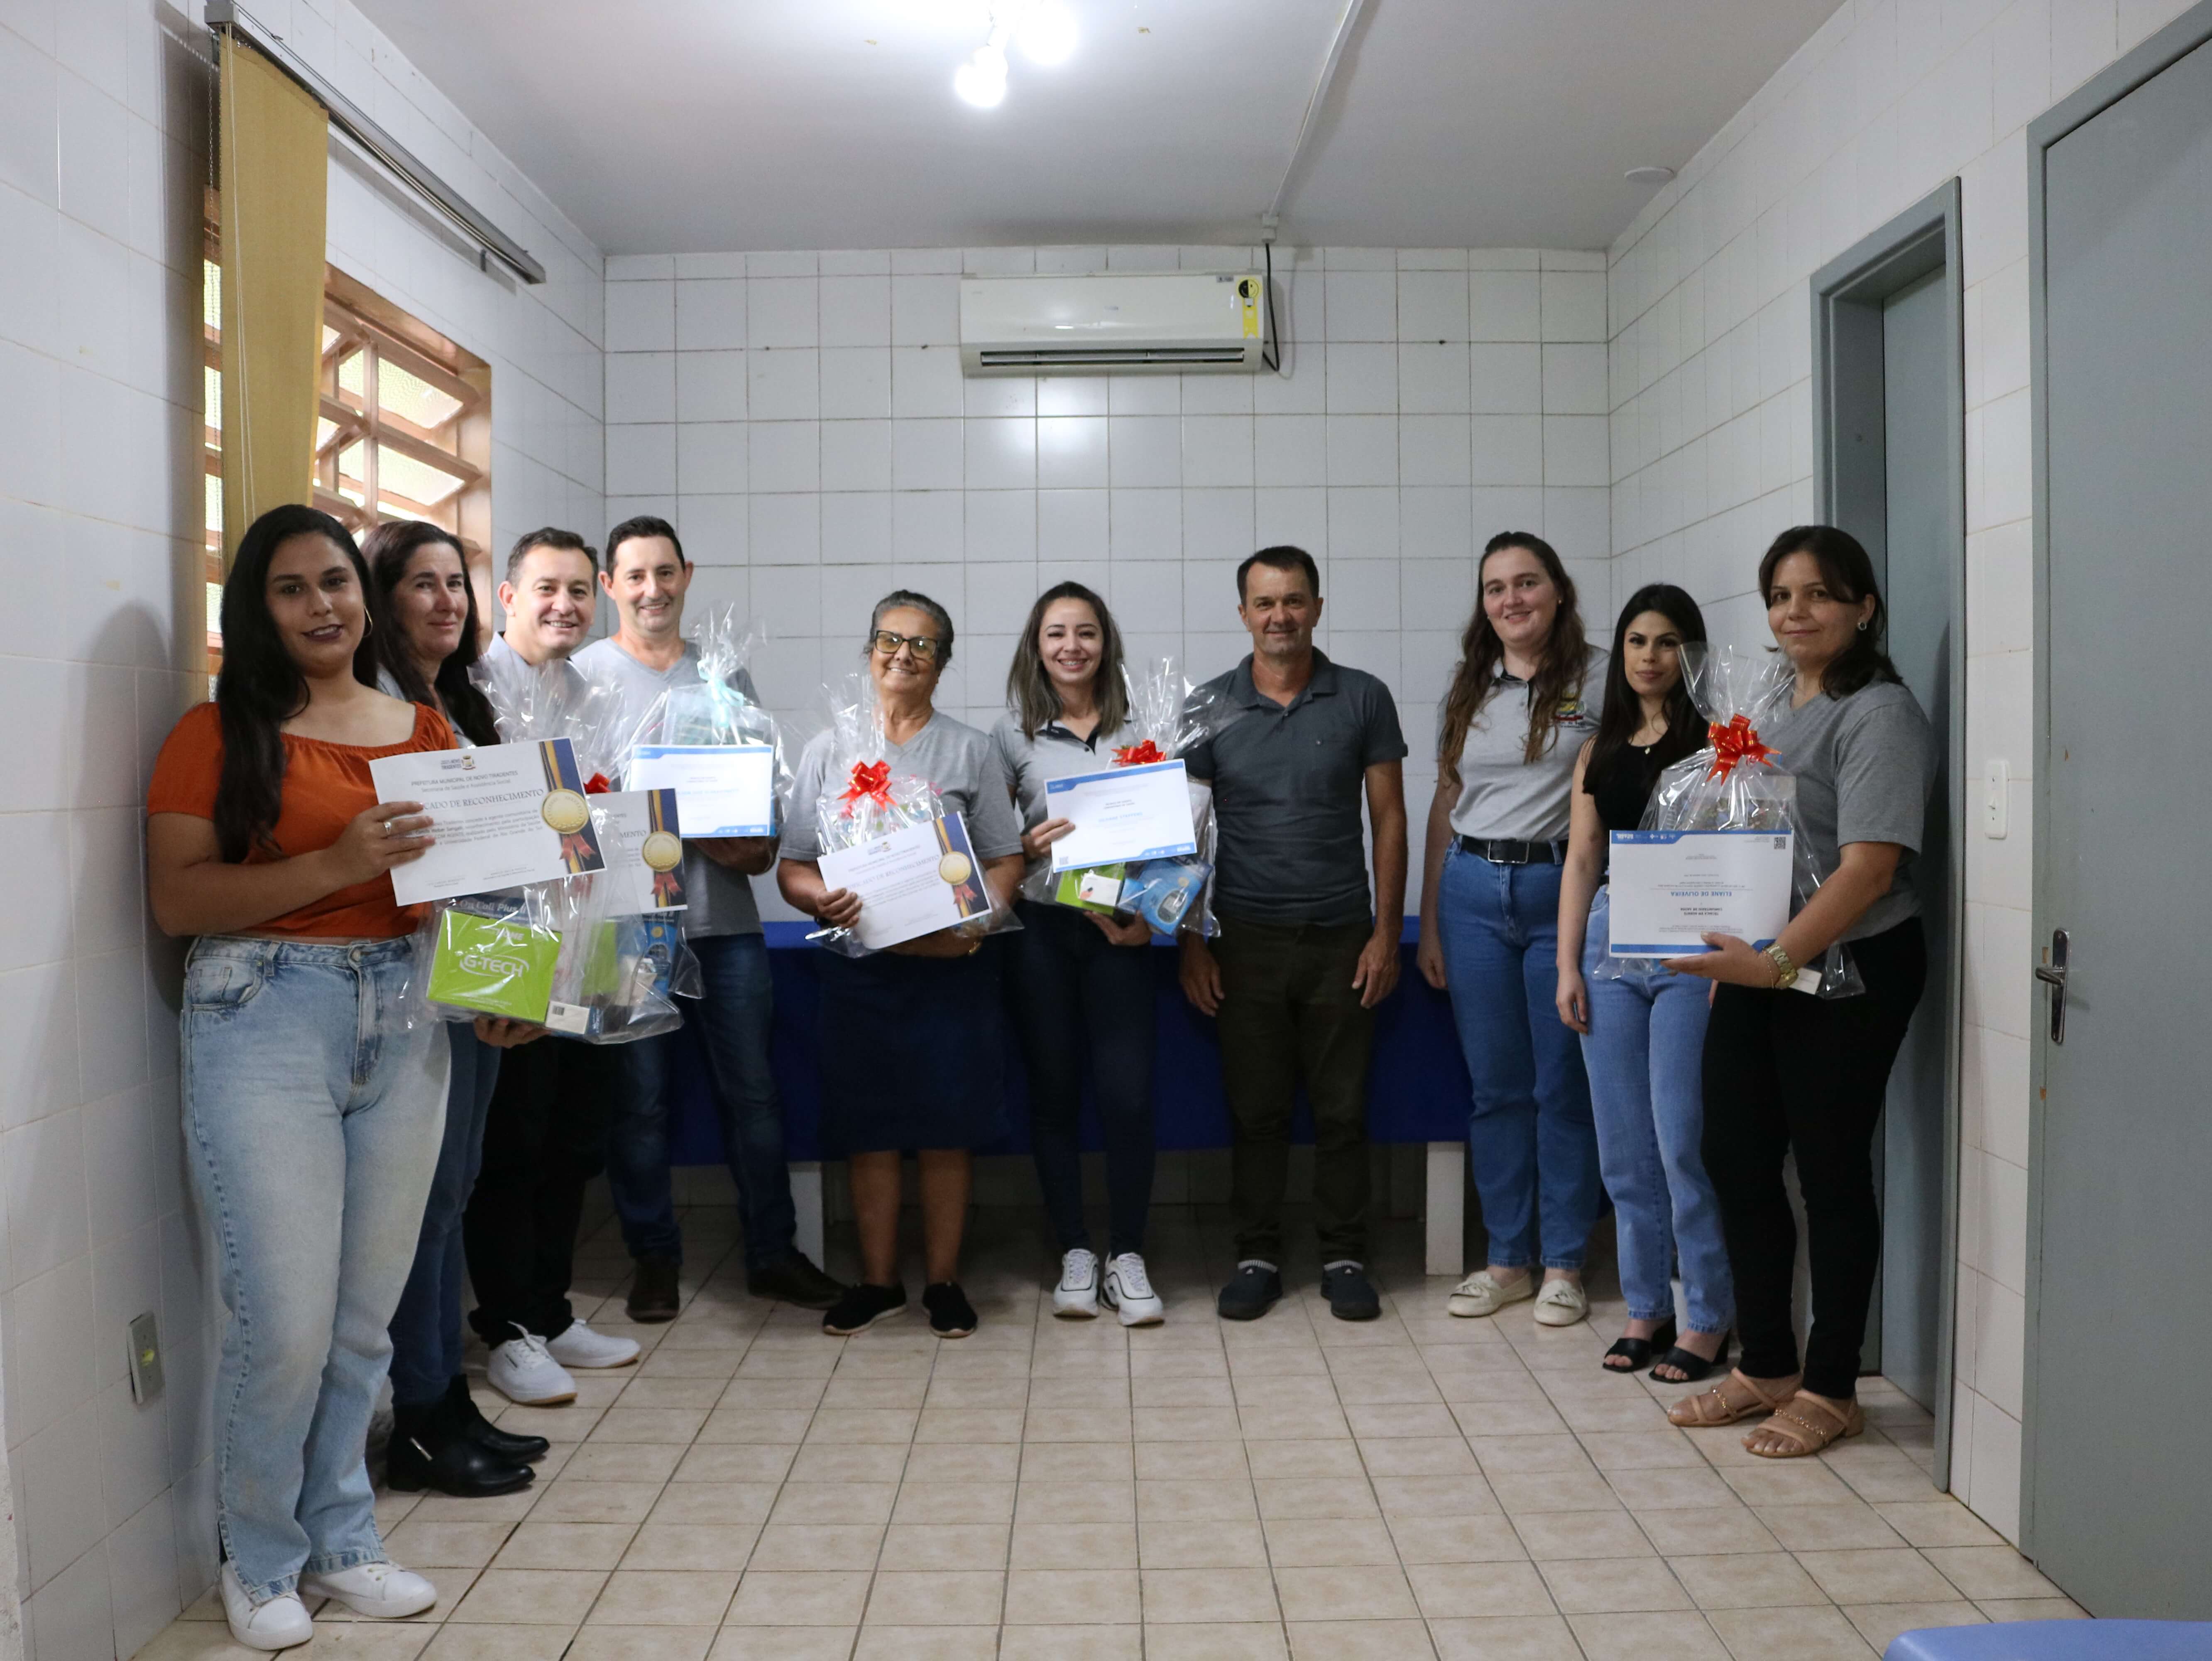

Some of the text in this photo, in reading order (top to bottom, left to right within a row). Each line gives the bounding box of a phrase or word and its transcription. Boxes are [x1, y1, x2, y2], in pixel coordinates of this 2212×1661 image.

[462, 789, 543, 806] RECONHECIMENTO
[620, 830, 646, 838] MENTO
[476, 901, 495, 911] Call
[464, 955, 524, 977] G-TECH
